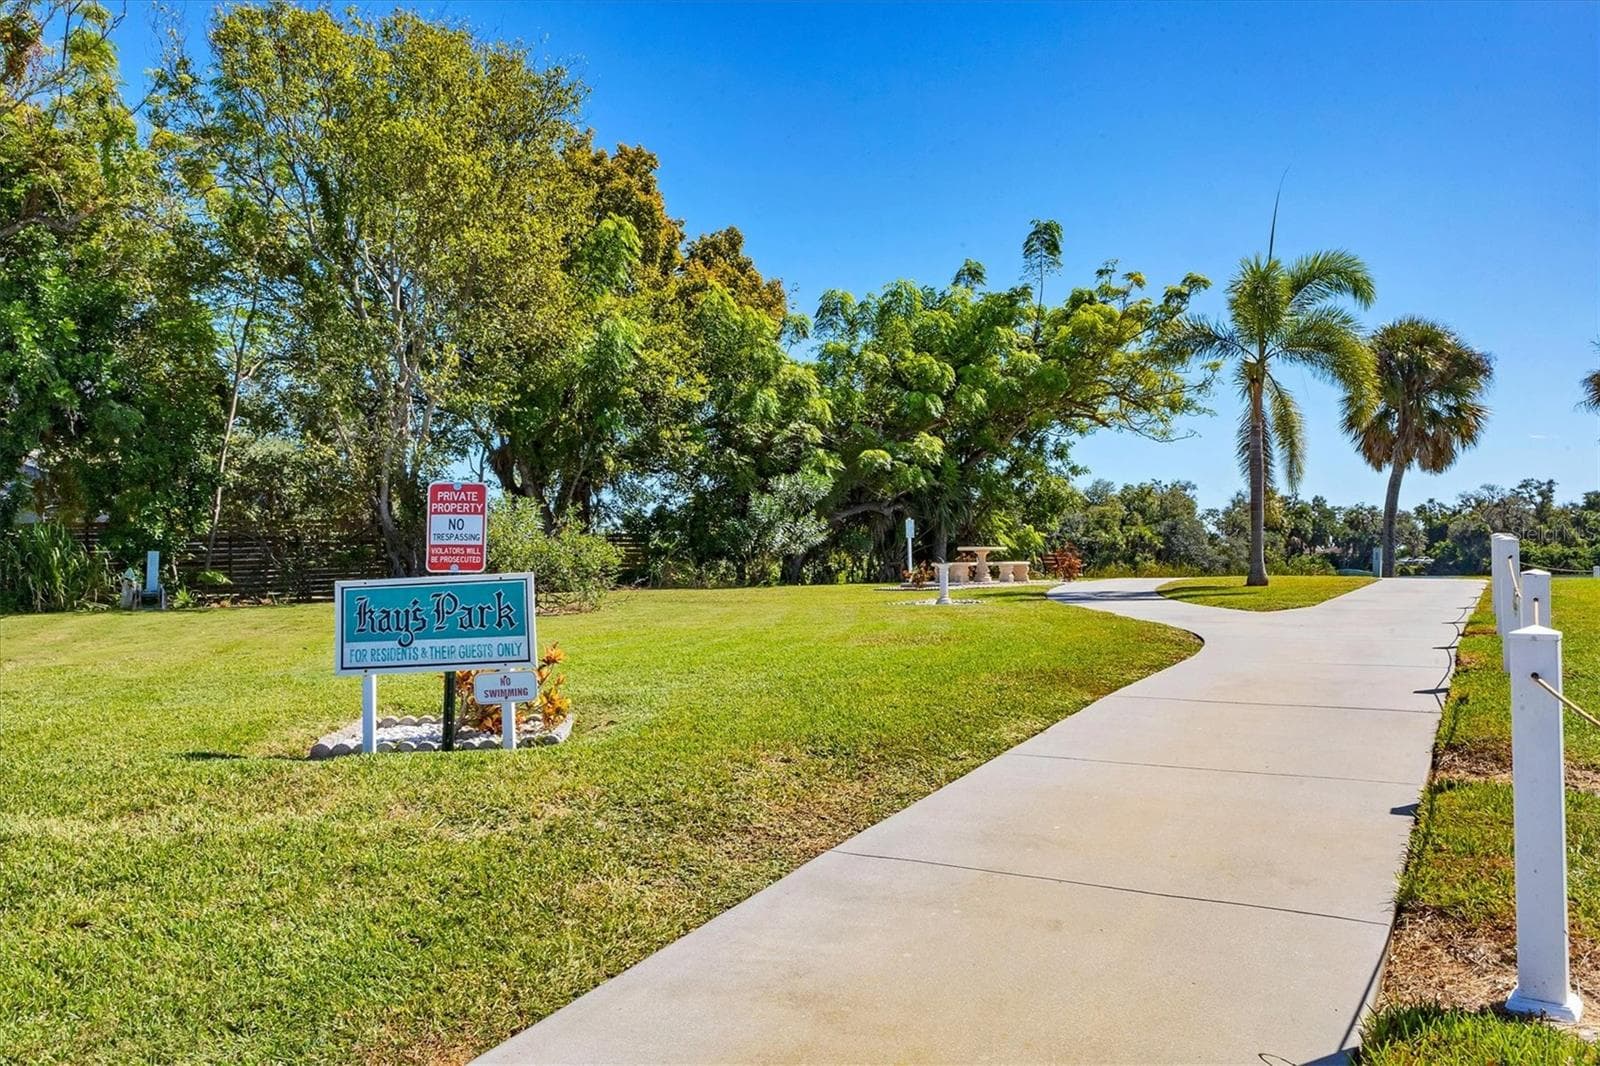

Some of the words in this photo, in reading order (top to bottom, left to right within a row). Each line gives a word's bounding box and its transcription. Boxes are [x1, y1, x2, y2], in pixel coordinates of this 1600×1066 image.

[437, 491, 478, 501] PRIVATE
[431, 503, 484, 513] PROPERTY
[448, 518, 465, 531] NO
[433, 533, 481, 541] TRESPASSING
[431, 547, 465, 555] VIOLATORS
[466, 547, 481, 555] WILL
[430, 555, 439, 563] BE
[440, 555, 481, 563] PROSECUTED
[430, 590, 517, 630] Park
[349, 649, 368, 663] FOR
[370, 646, 419, 662] RESIDENTS
[421, 647, 428, 659] &
[458, 643, 493, 658] GUESTS
[497, 642, 523, 657] ONLY
[500, 677, 511, 686] NO
[484, 687, 529, 698] SWIMMING
